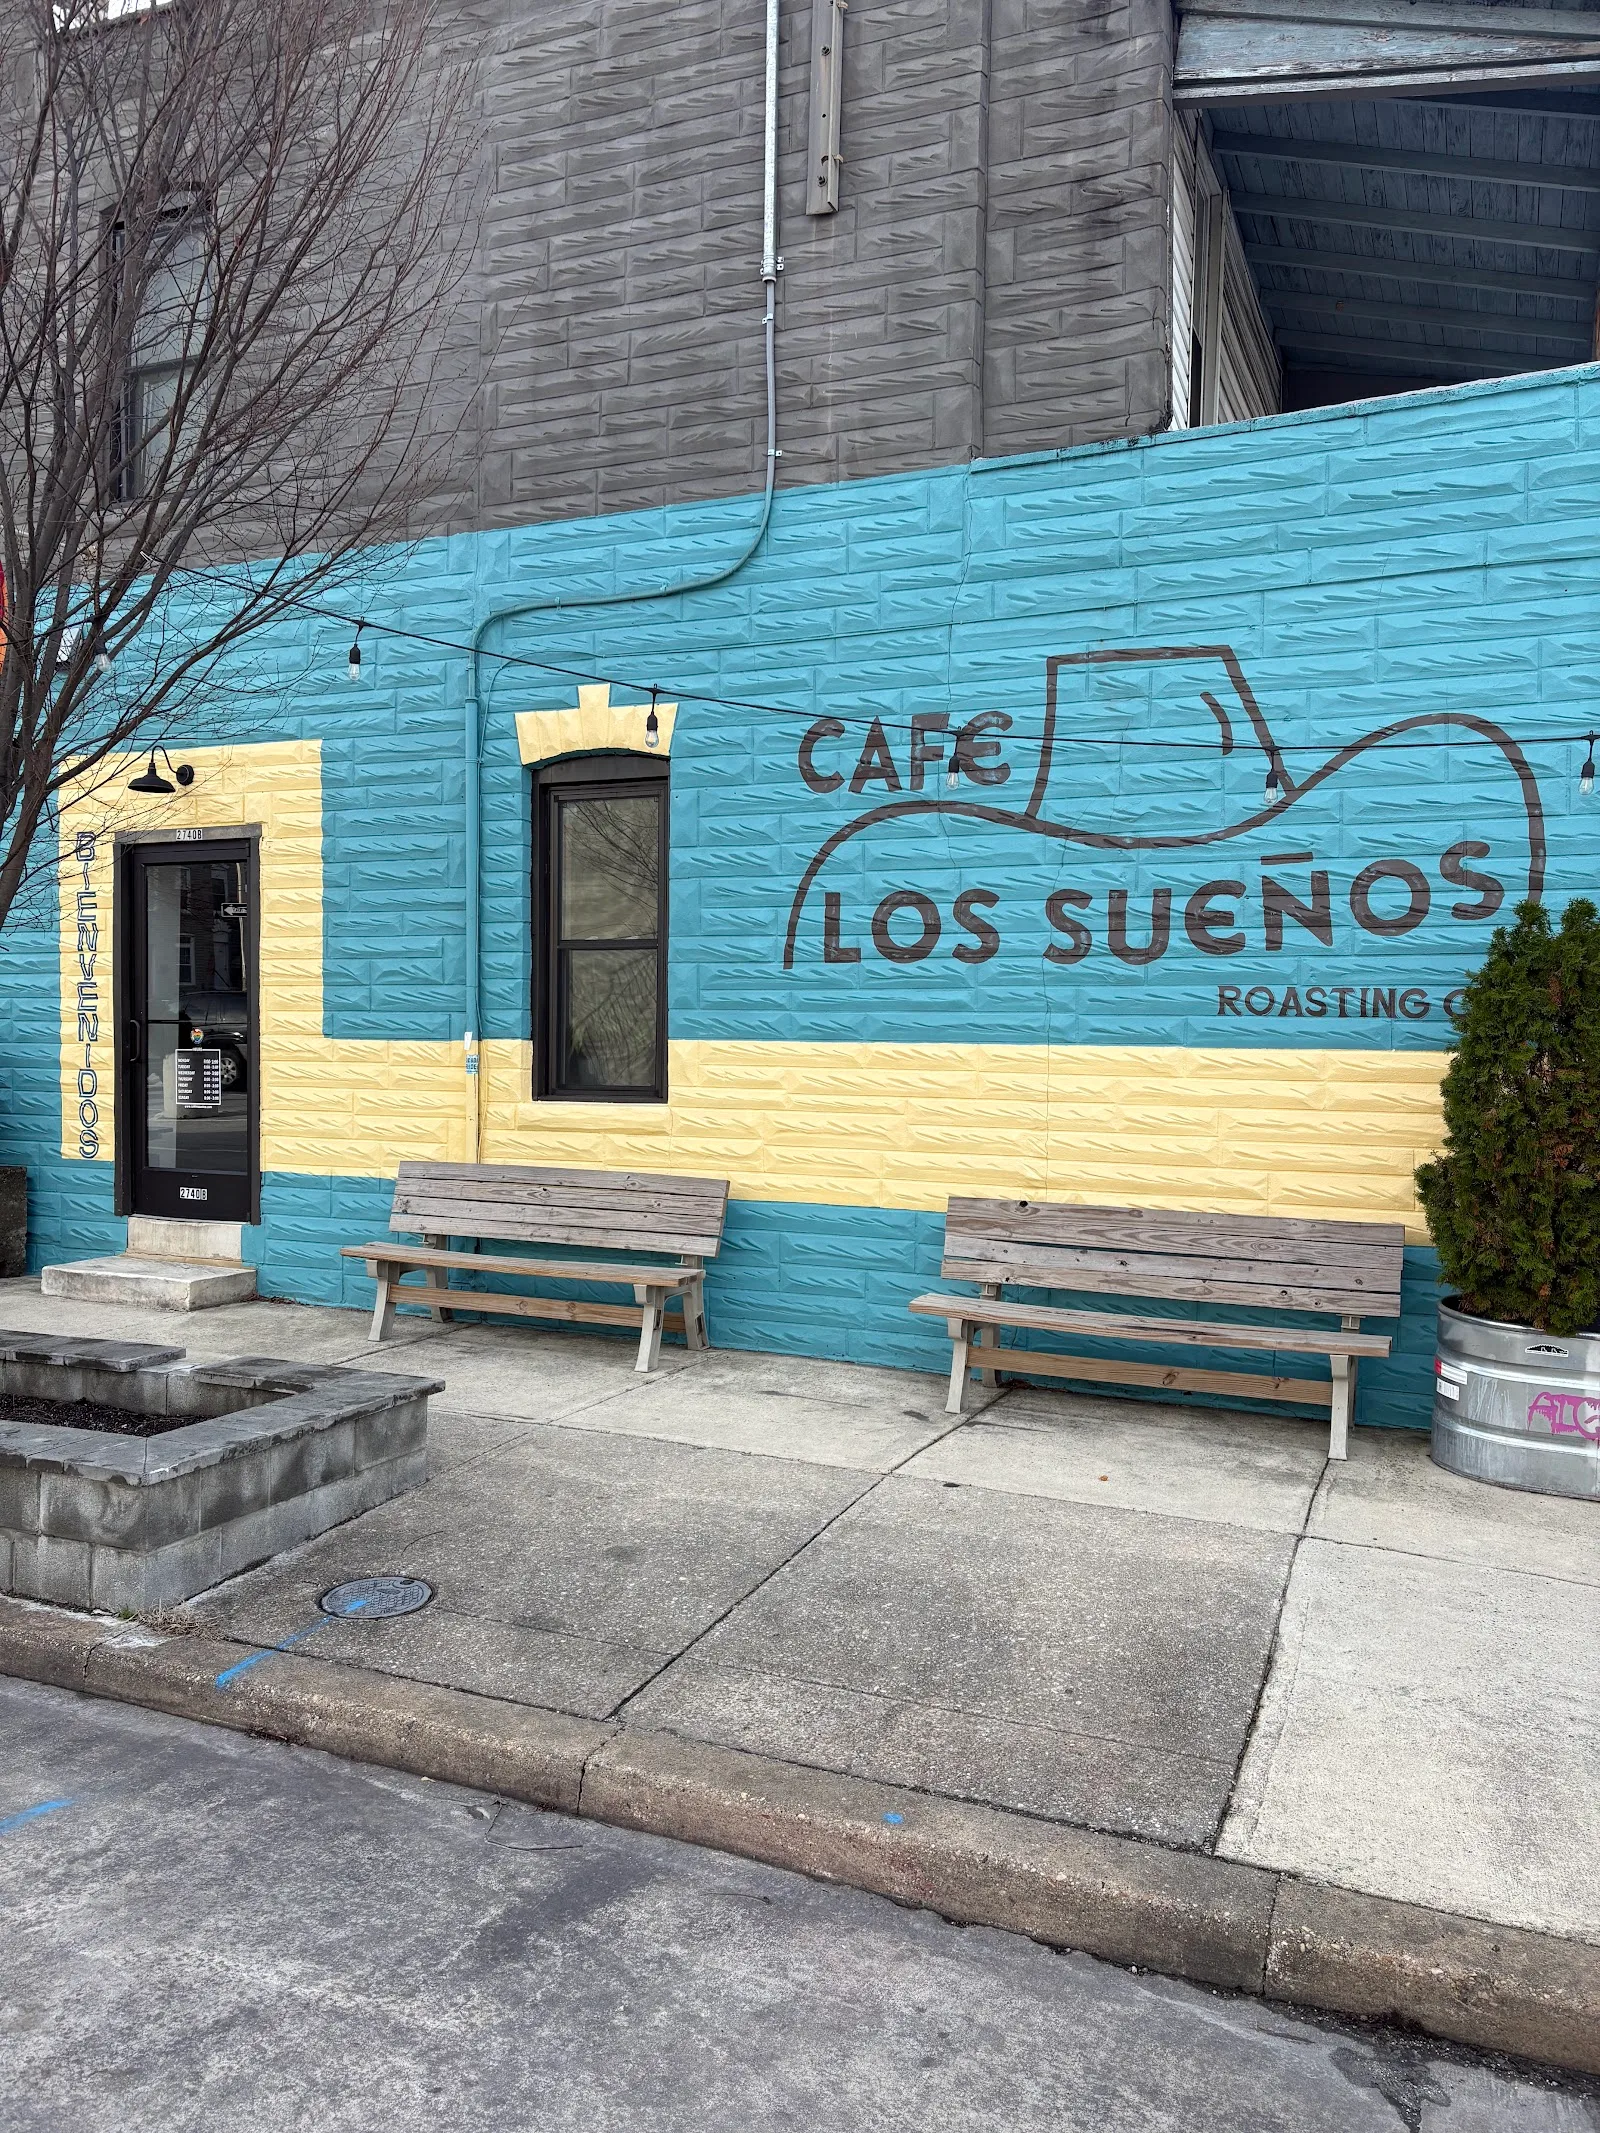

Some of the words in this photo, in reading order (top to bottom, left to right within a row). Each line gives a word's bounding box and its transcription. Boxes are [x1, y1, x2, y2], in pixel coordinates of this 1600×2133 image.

[798, 711, 1013, 793] CAFE
[176, 829, 202, 840] 2740B
[823, 888, 1000, 965] LOS
[1043, 841, 1506, 966] SUEÑOS
[76, 831, 100, 1159] BIENVENIDOS
[1217, 985, 1431, 1019] ROASTING
[1443, 988, 1469, 1019] C
[180, 1188, 207, 1200] 2740B
